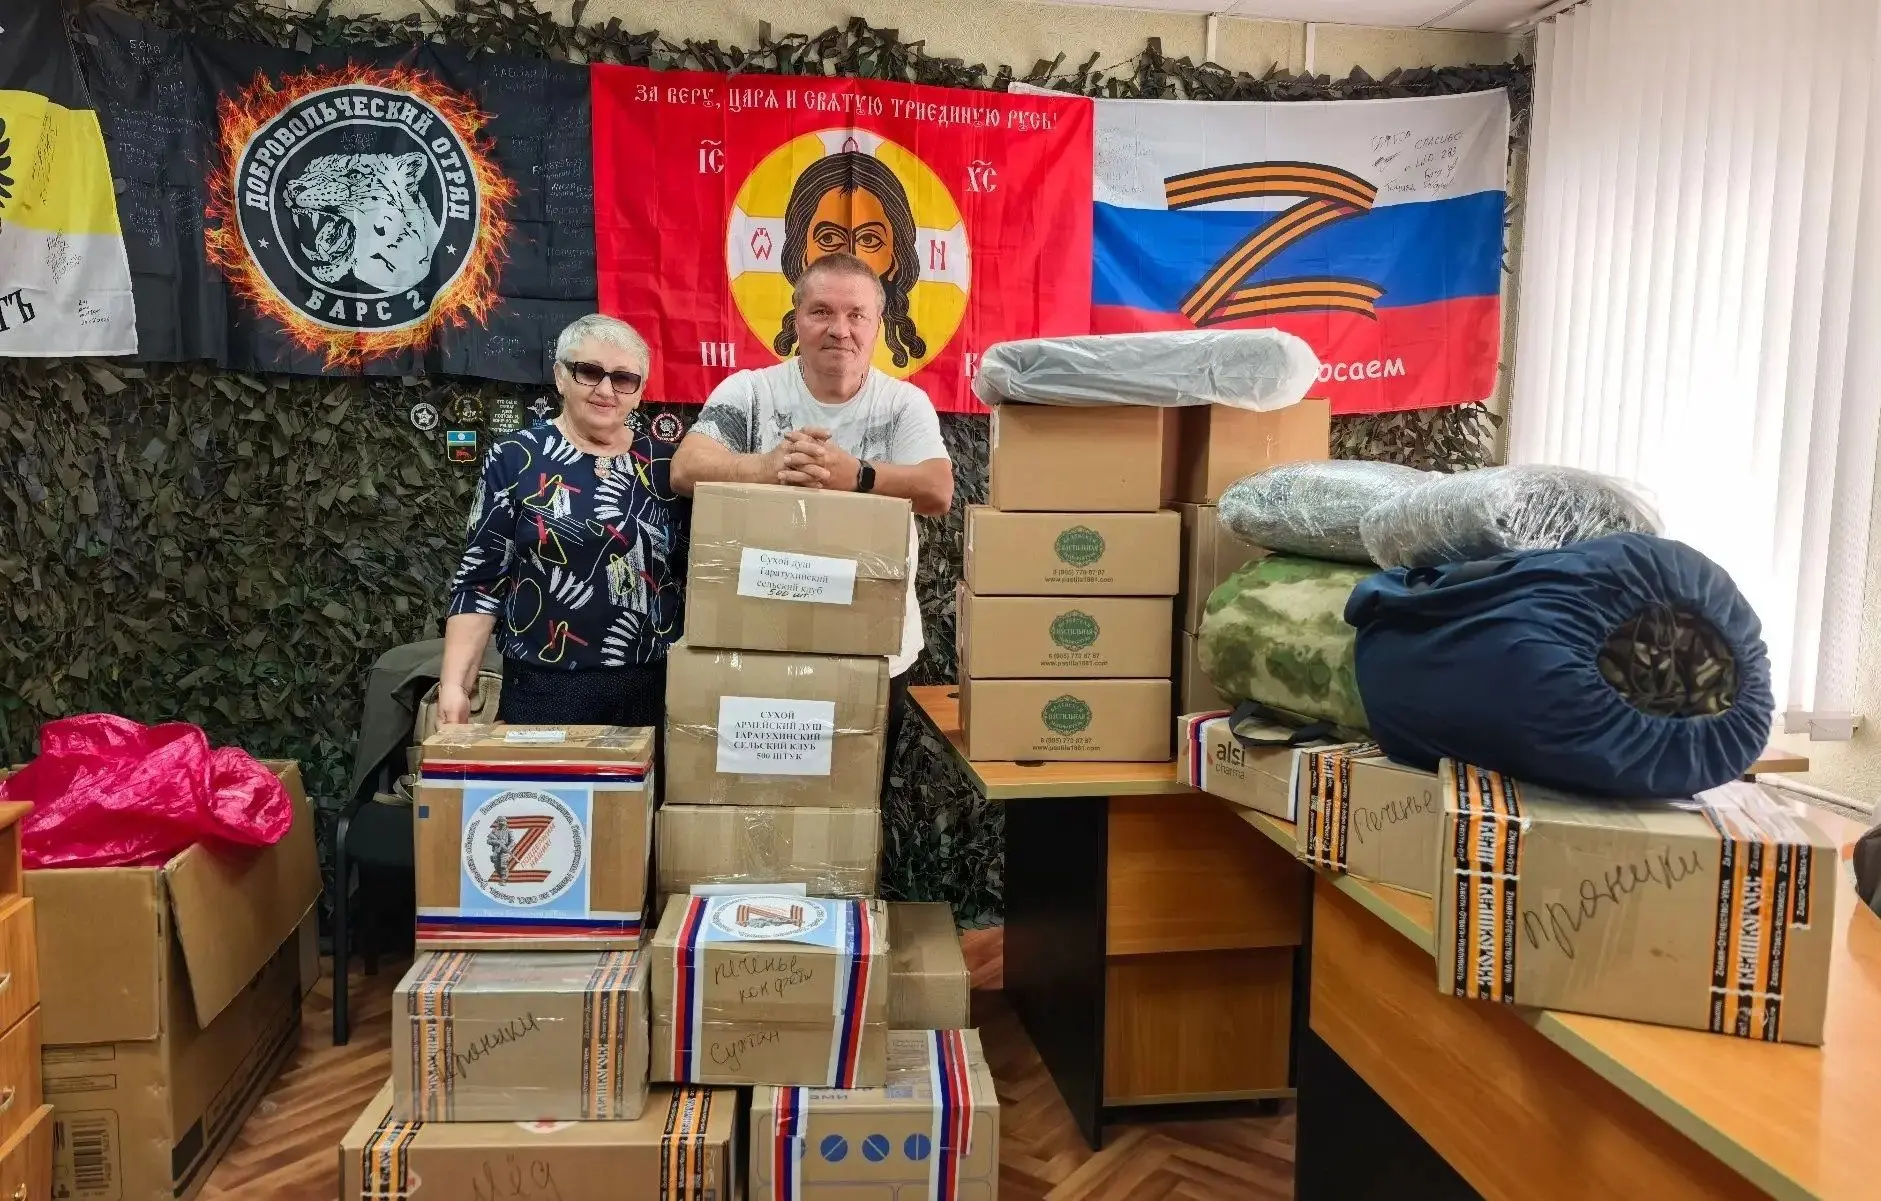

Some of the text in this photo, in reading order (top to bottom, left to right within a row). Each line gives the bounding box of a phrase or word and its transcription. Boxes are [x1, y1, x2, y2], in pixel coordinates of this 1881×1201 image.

[634, 84, 658, 102] ЗА
[246, 96, 434, 211] ДОБРОВОЛЬЧЕСКИЙ
[431, 136, 470, 220] ОТРЯД
[305, 289, 425, 322] БАРС 2
[964, 352, 981, 377] К
[1317, 357, 1406, 383] осаем
[760, 553, 812, 570] Сухой душ
[756, 580, 823, 596] сельский клуб
[760, 711, 795, 720] СУХОЙ
[735, 720, 822, 732] АРМЕЙСКИЙ ДУШ
[733, 741, 816, 751] СЕЛЬСКИЙ КЛУБ
[1216, 741, 1246, 767] alsi
[756, 752, 803, 760] 500 ШТУК
